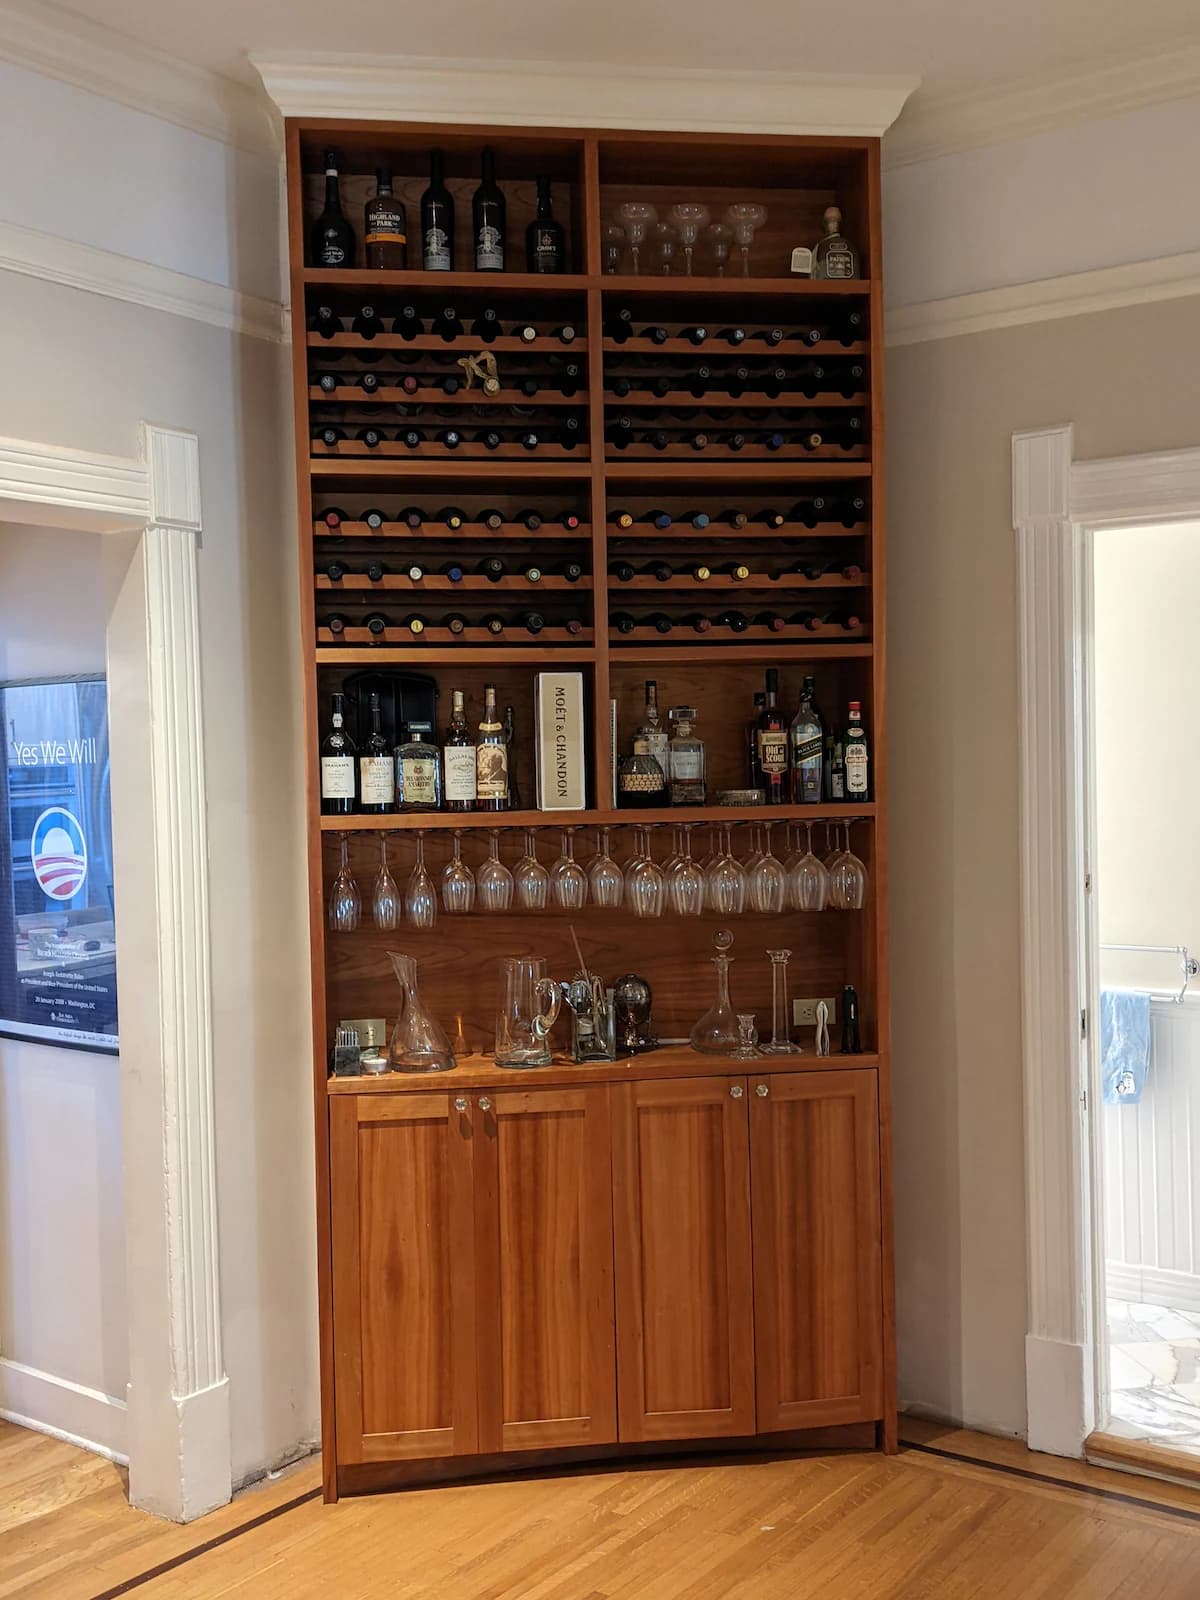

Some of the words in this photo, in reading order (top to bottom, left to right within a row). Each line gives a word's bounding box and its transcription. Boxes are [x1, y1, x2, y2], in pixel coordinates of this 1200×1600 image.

[555, 687, 567, 722] MOËT
[14, 740, 39, 766] Yes
[40, 739, 66, 765] We
[67, 737, 97, 764] Will
[556, 735, 568, 797] CHANDON
